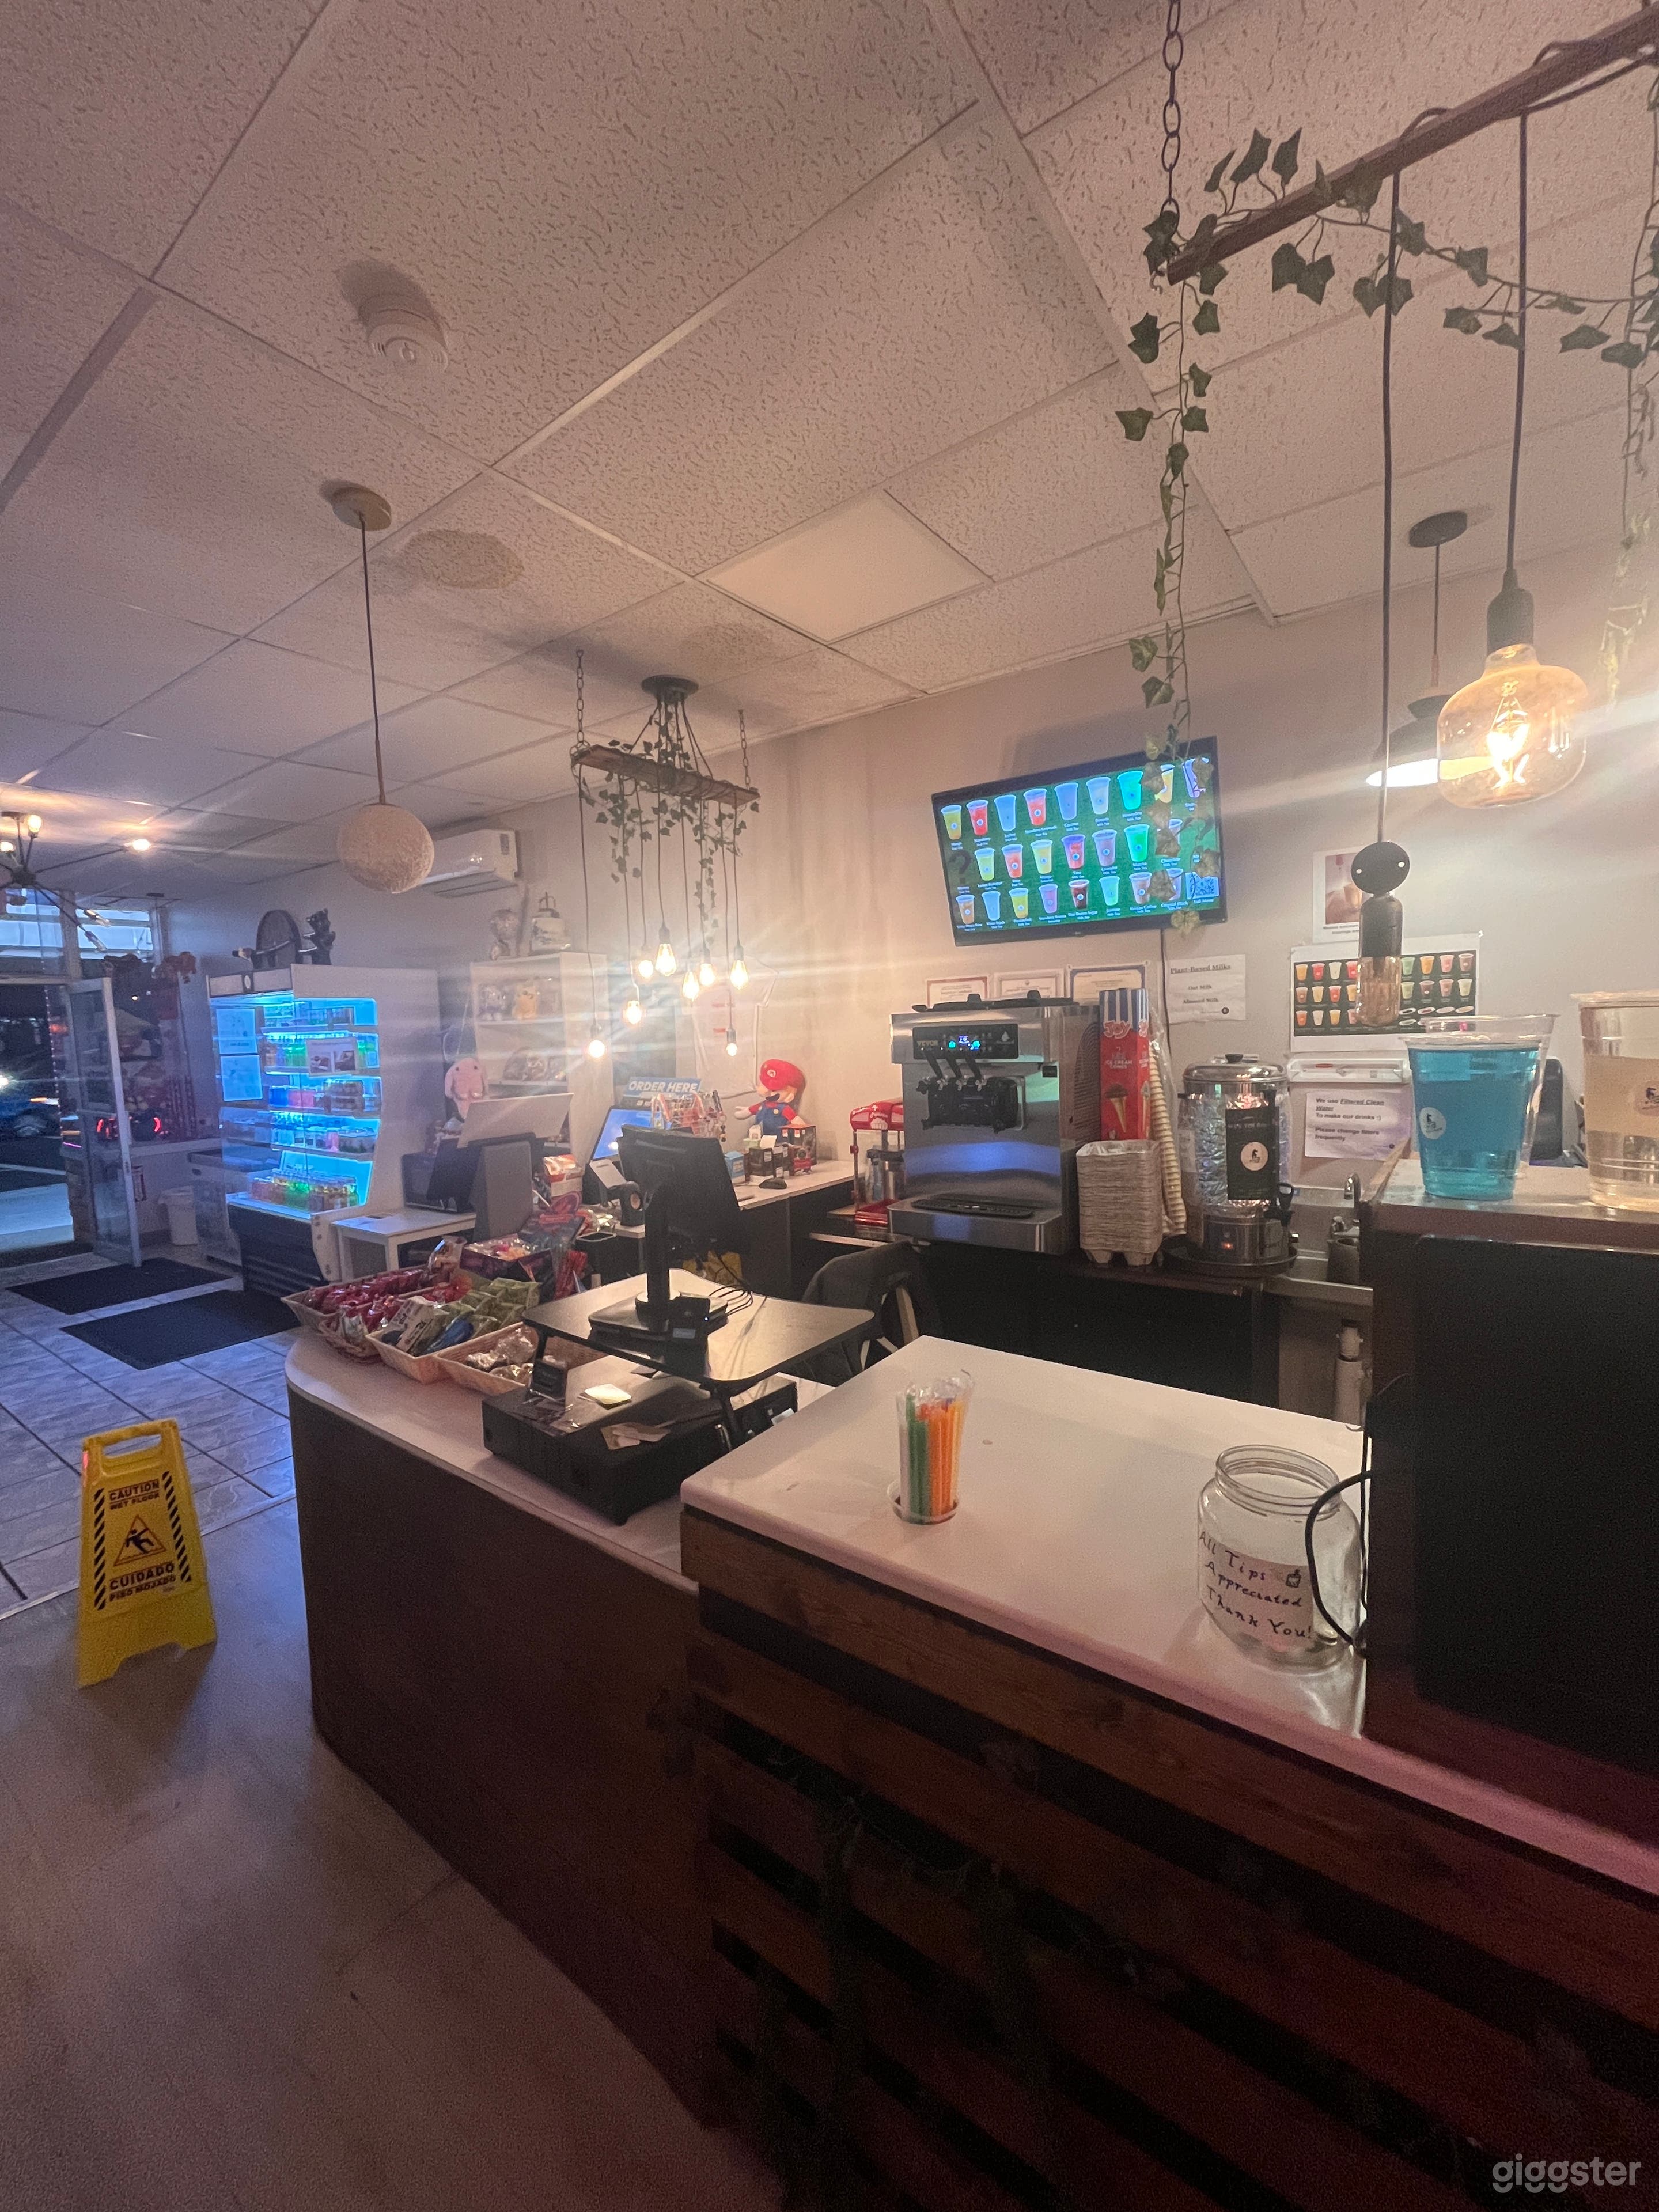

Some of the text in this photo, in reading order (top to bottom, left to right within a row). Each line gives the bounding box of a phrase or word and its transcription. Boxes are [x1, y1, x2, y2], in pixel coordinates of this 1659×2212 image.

[1171, 965, 1210, 974] Plant-Based
[628, 1080, 698, 1093] ORDER HERE
[109, 1480, 160, 1501] CAUTION
[109, 1492, 160, 1510] WET FLOOR
[1199, 1531, 1266, 1580] All Tips
[109, 1562, 174, 1590] CUIDADO
[109, 1573, 176, 1602] PISO MOJADO
[1205, 1561, 1302, 1607] Appreciated
[1207, 1584, 1312, 1639] Thank You!
